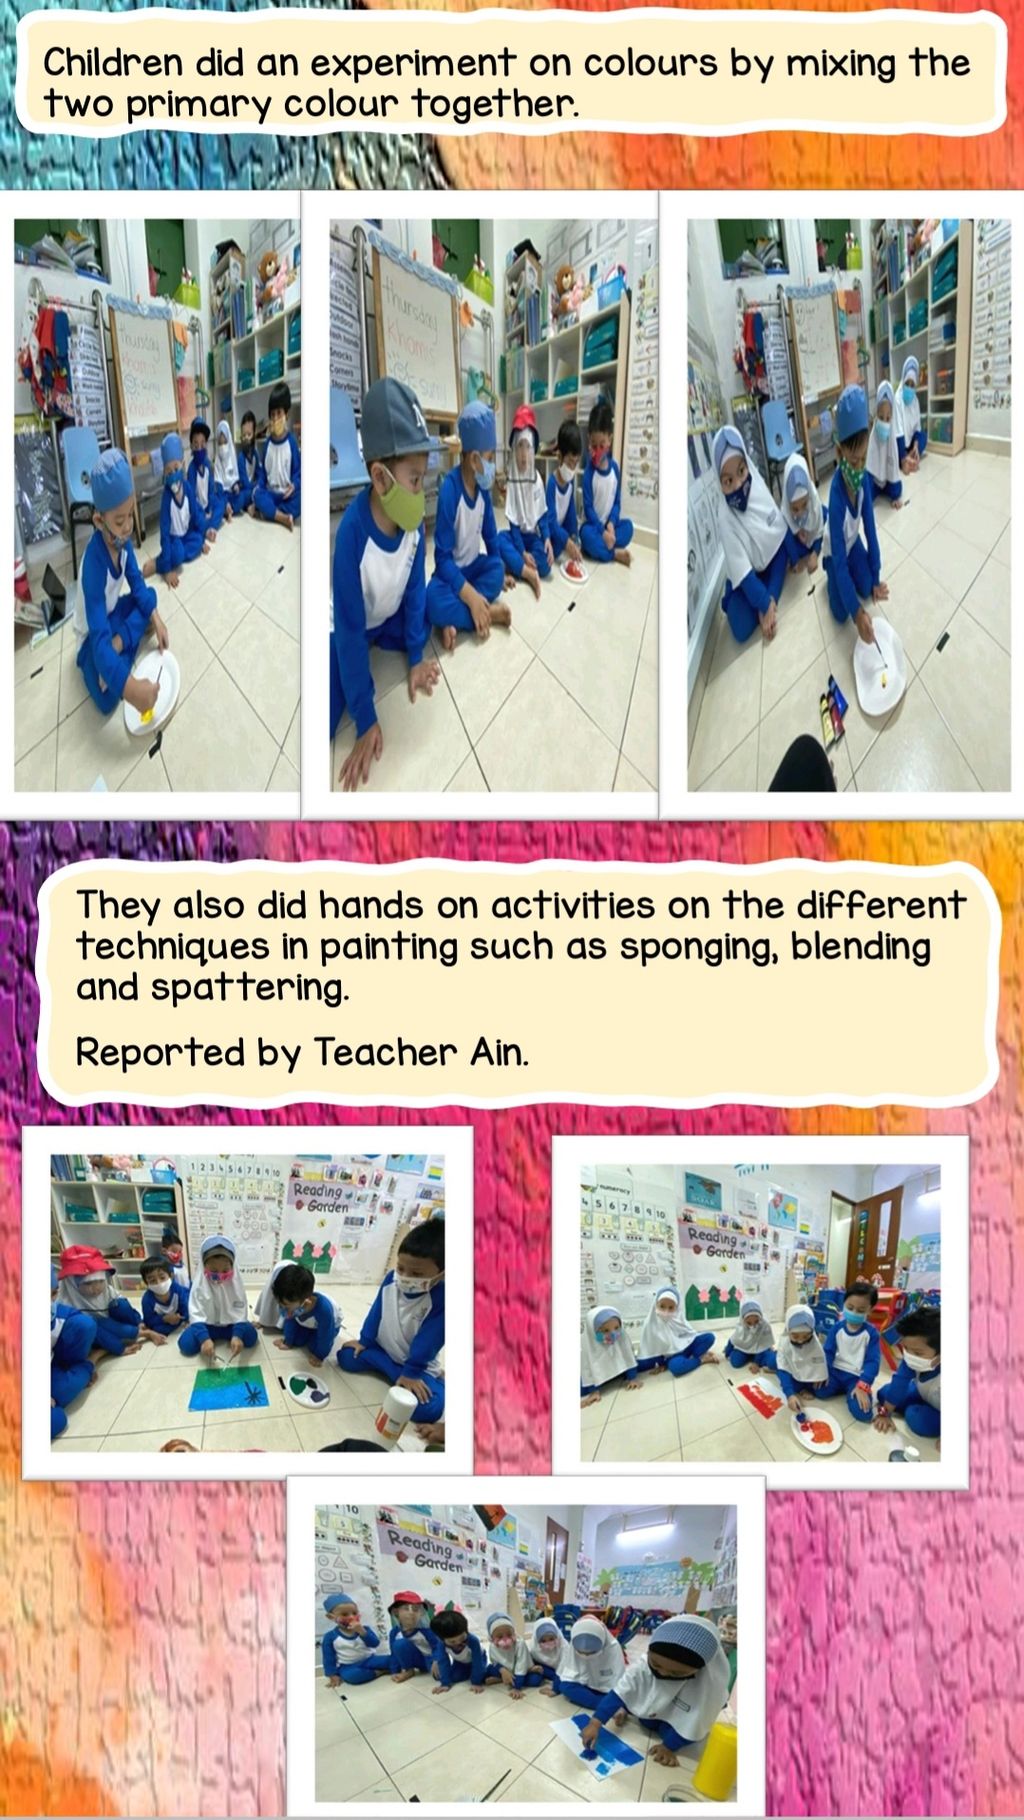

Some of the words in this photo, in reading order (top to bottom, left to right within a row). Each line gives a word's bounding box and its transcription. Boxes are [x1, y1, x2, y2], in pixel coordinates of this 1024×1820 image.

[272, 1169, 280, 1177] 10
[294, 1183, 343, 1199] Reading
[307, 1199, 349, 1213] Garden
[595, 1199, 602, 1208] 5
[609, 1201, 615, 1210] 6
[621, 1203, 628, 1212] 7
[634, 1205, 640, 1214] 8
[646, 1208, 652, 1216] 9
[656, 1210, 666, 1219] 10
[688, 1227, 737, 1247] Reading
[706, 1245, 746, 1259] Garden
[346, 1504, 359, 1515] 10
[387, 1529, 453, 1559] Reading
[414, 1554, 464, 1573] Garden
